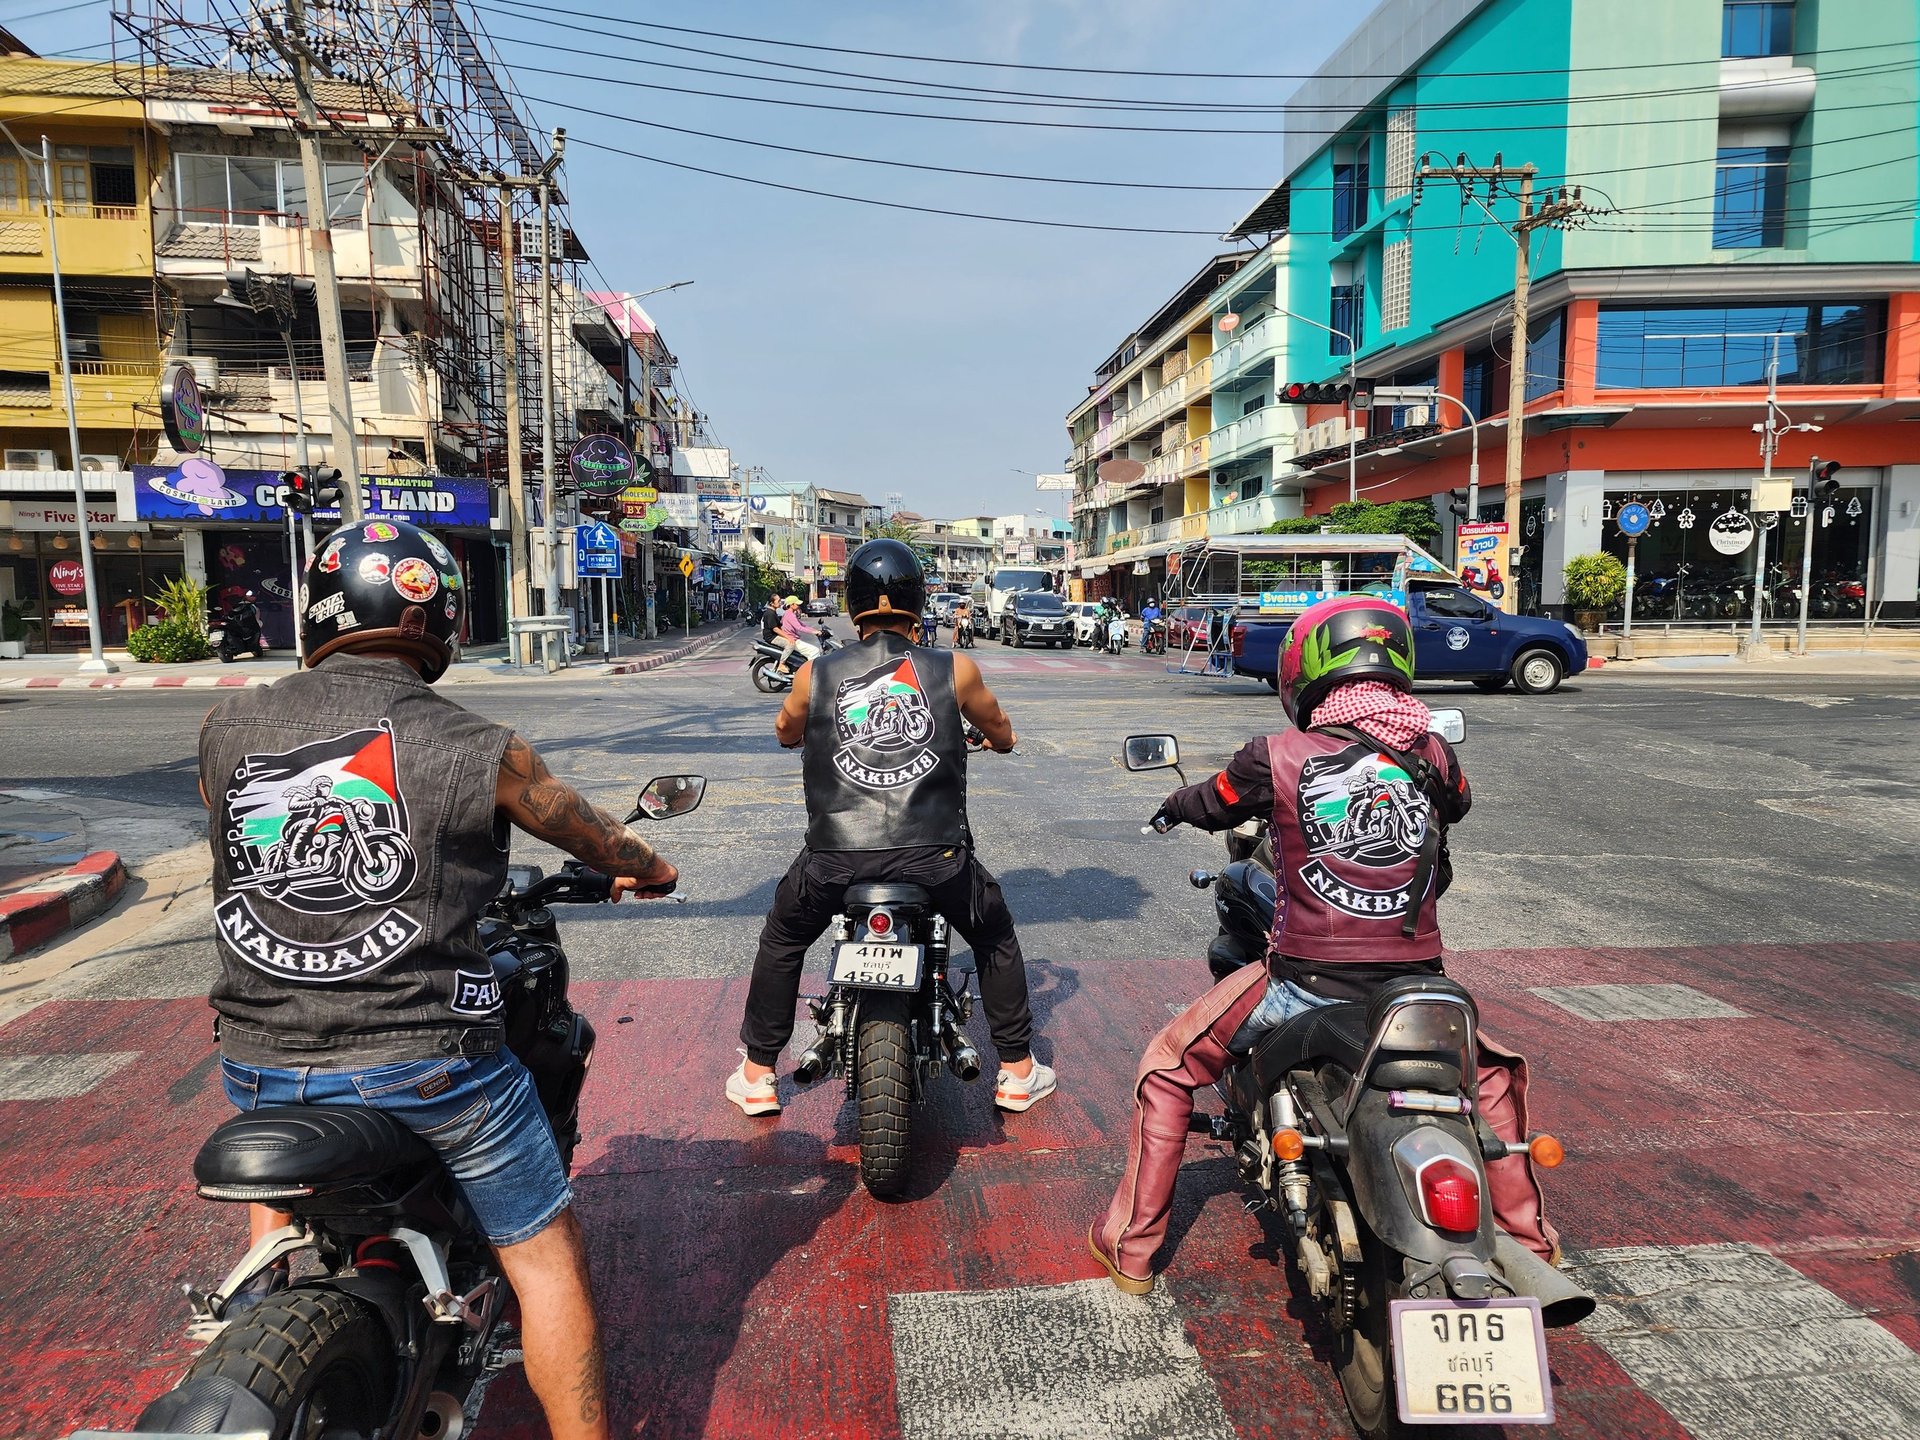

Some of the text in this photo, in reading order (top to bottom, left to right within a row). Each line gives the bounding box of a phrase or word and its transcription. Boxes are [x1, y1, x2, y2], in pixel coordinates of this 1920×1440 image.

[376, 478, 434, 487] RELAXATION
[158, 485, 197, 503] COSMIC
[381, 490, 455, 512] LAND
[44, 511, 75, 522] Five
[627, 506, 642, 514] BY
[1472, 537, 1494, 551] ดาวน์
[53, 565, 83, 581] Ning's
[309, 593, 343, 618] SANTA
[316, 602, 344, 622] CRUZ
[840, 754, 933, 785] NAKBA48
[225, 907, 407, 973] NAKBA48
[863, 961, 892, 971] ชลบุรี
[844, 971, 905, 985] 4504
[1431, 1313, 1504, 1343] จคธ
[1448, 1352, 1494, 1378] ชลบุรี
[1436, 1383, 1512, 1413] 666
